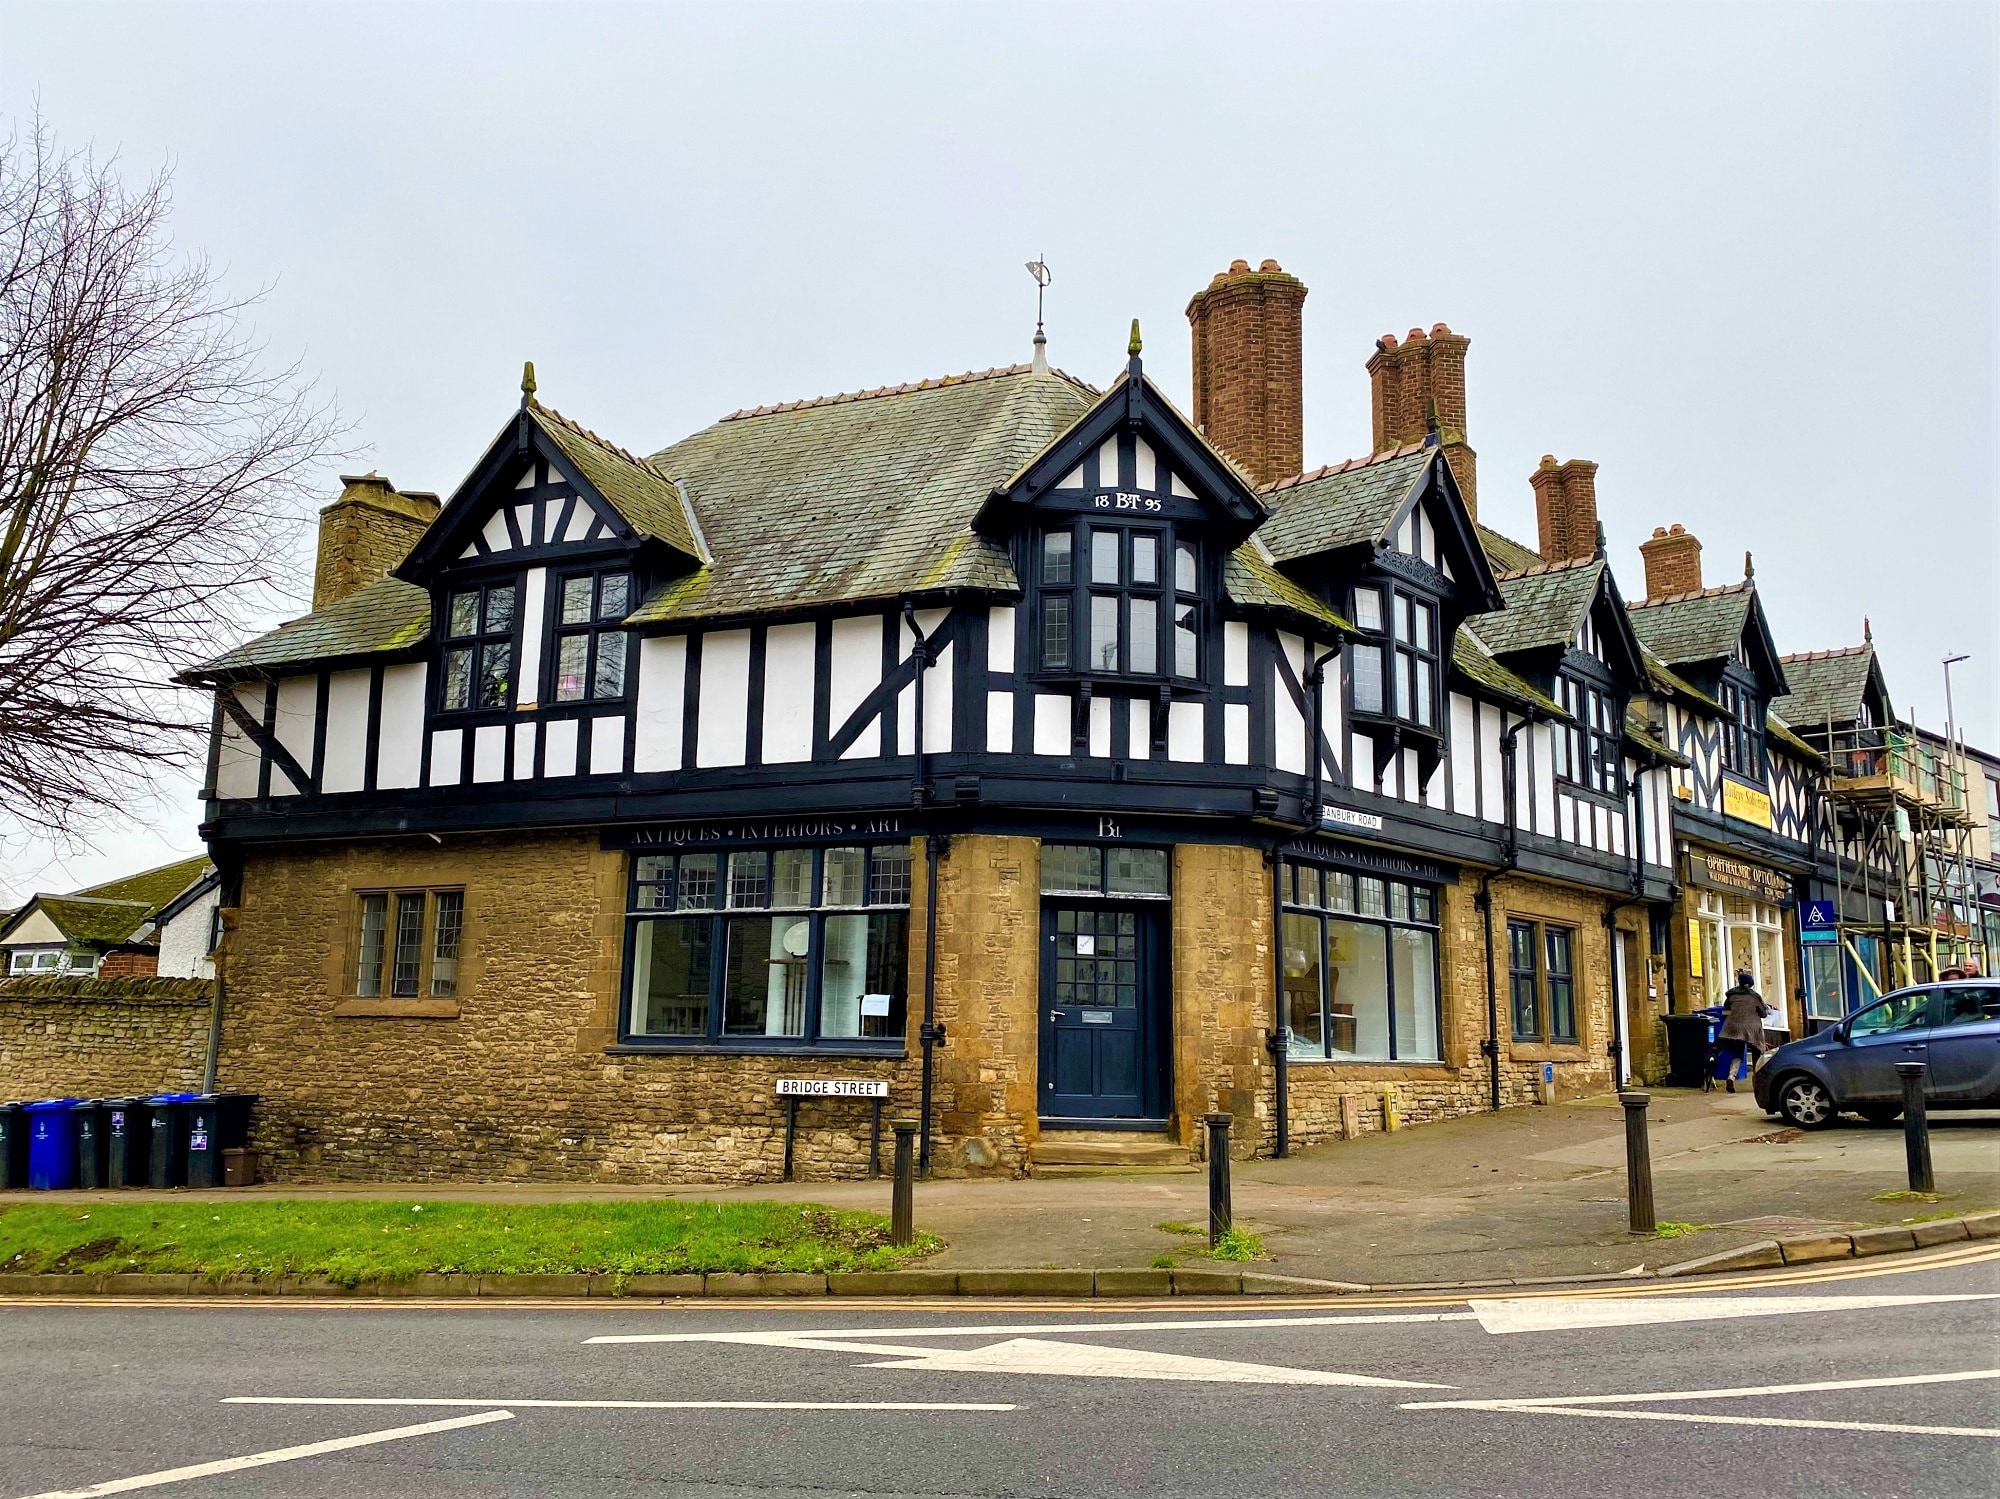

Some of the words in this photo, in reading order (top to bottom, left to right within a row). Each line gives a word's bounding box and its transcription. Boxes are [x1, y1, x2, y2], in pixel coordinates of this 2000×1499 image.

[1095, 495, 1110, 508] 18
[1144, 498, 1162, 512] 95
[1358, 814, 1377, 827] ROAD
[631, 826, 722, 846] ANTIQUES
[741, 821, 844, 839] INTERIORS
[864, 817, 903, 834] ART
[1289, 839, 1347, 861] ANTIQUES
[1357, 850, 1413, 873] INTERIORS
[1422, 864, 1440, 878] ART
[1706, 855, 1752, 880] OPHTHALMIC
[782, 1081, 829, 1094] BRIDGE
[834, 1082, 881, 1095] STREET
